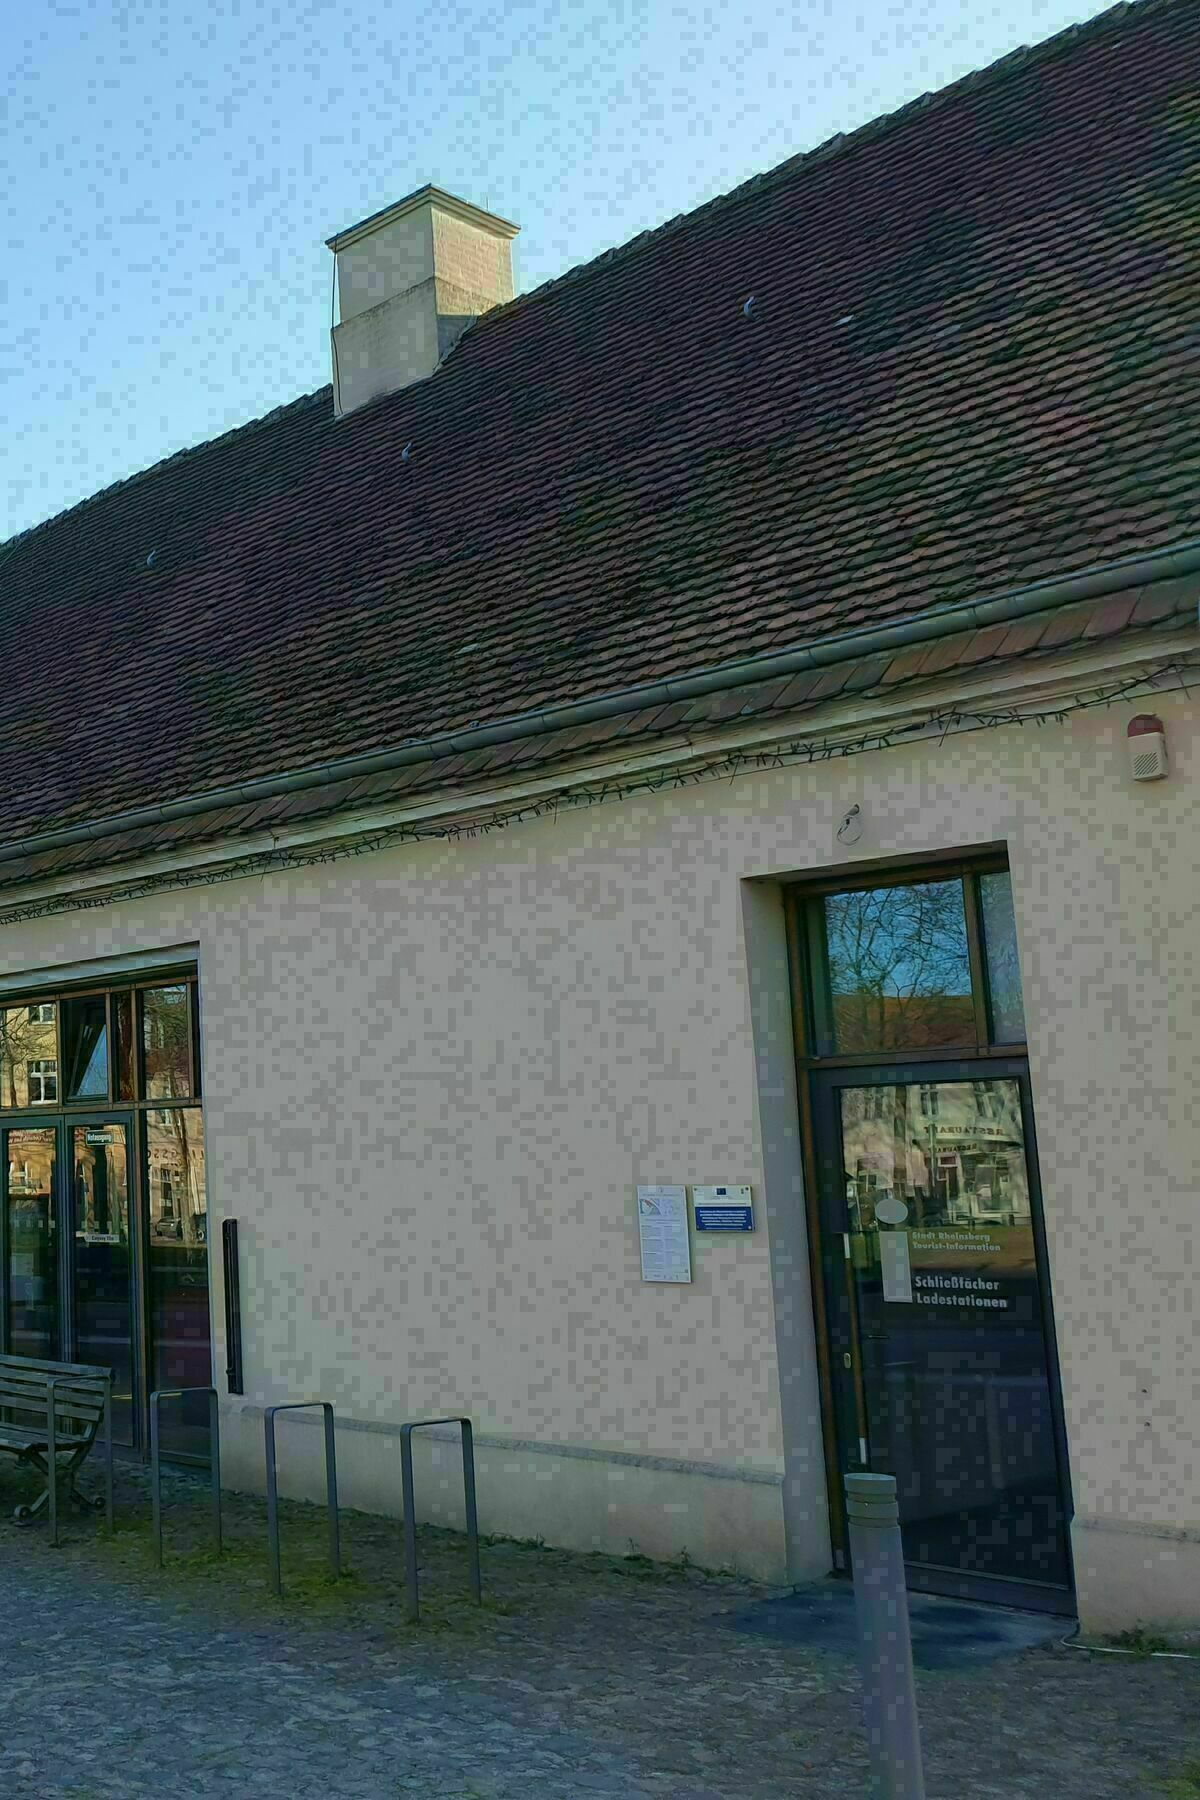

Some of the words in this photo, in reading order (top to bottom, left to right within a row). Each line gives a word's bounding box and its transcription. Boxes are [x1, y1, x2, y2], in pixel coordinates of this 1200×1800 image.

[912, 1231, 936, 1240] Stadt
[938, 1232, 991, 1243] Rheinsberg
[912, 1242, 1001, 1252] Tourist-Information
[915, 1276, 1000, 1290] Schließfächer
[917, 1292, 1008, 1308] Ladestationen
